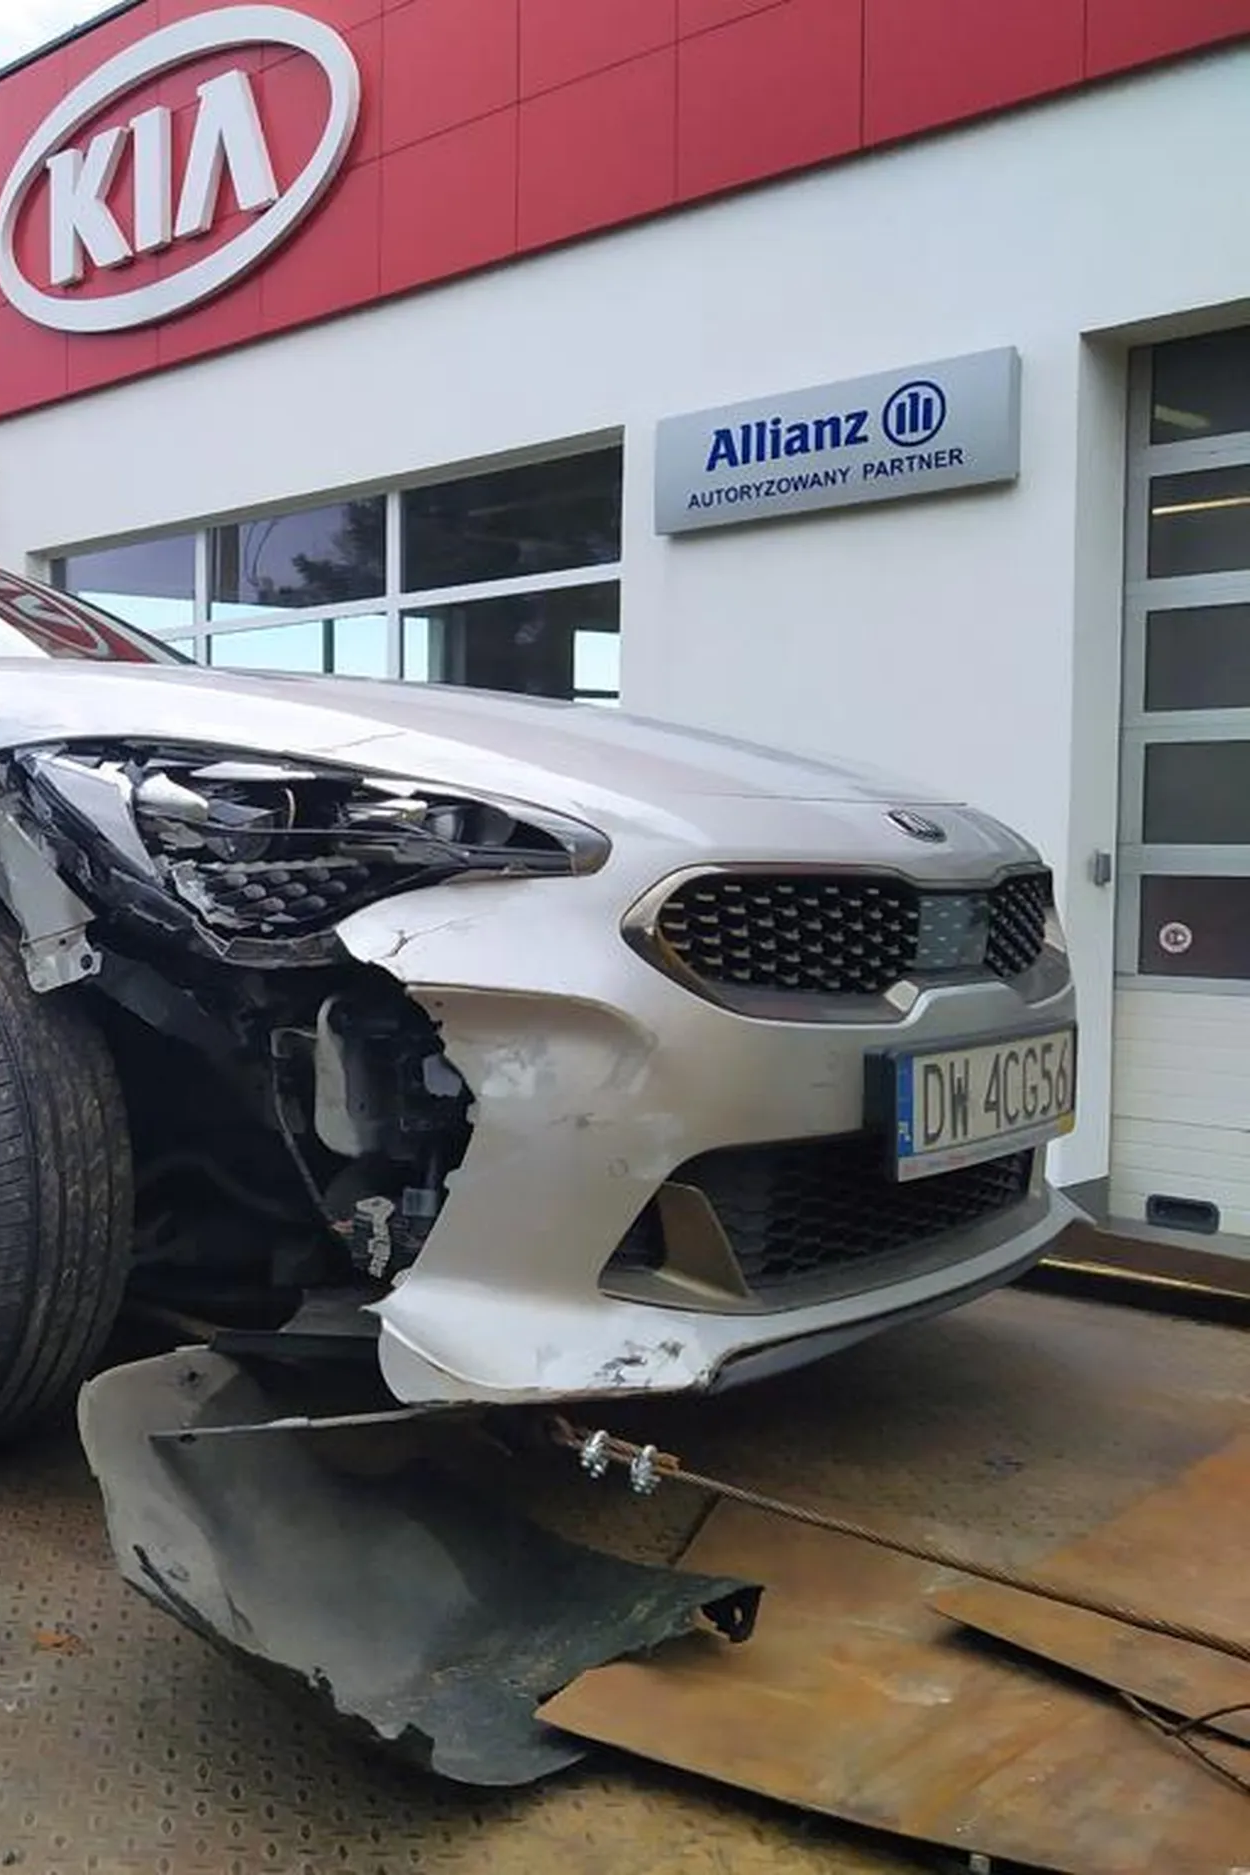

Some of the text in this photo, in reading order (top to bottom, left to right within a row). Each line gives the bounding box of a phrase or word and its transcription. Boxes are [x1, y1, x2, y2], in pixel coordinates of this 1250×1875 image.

[46, 69, 280, 287] KIA
[688, 447, 964, 510] AUTORYZOWANY PARTNER
[706, 410, 869, 472] Allianz
[922, 1038, 1068, 1146] DW 4CG56
